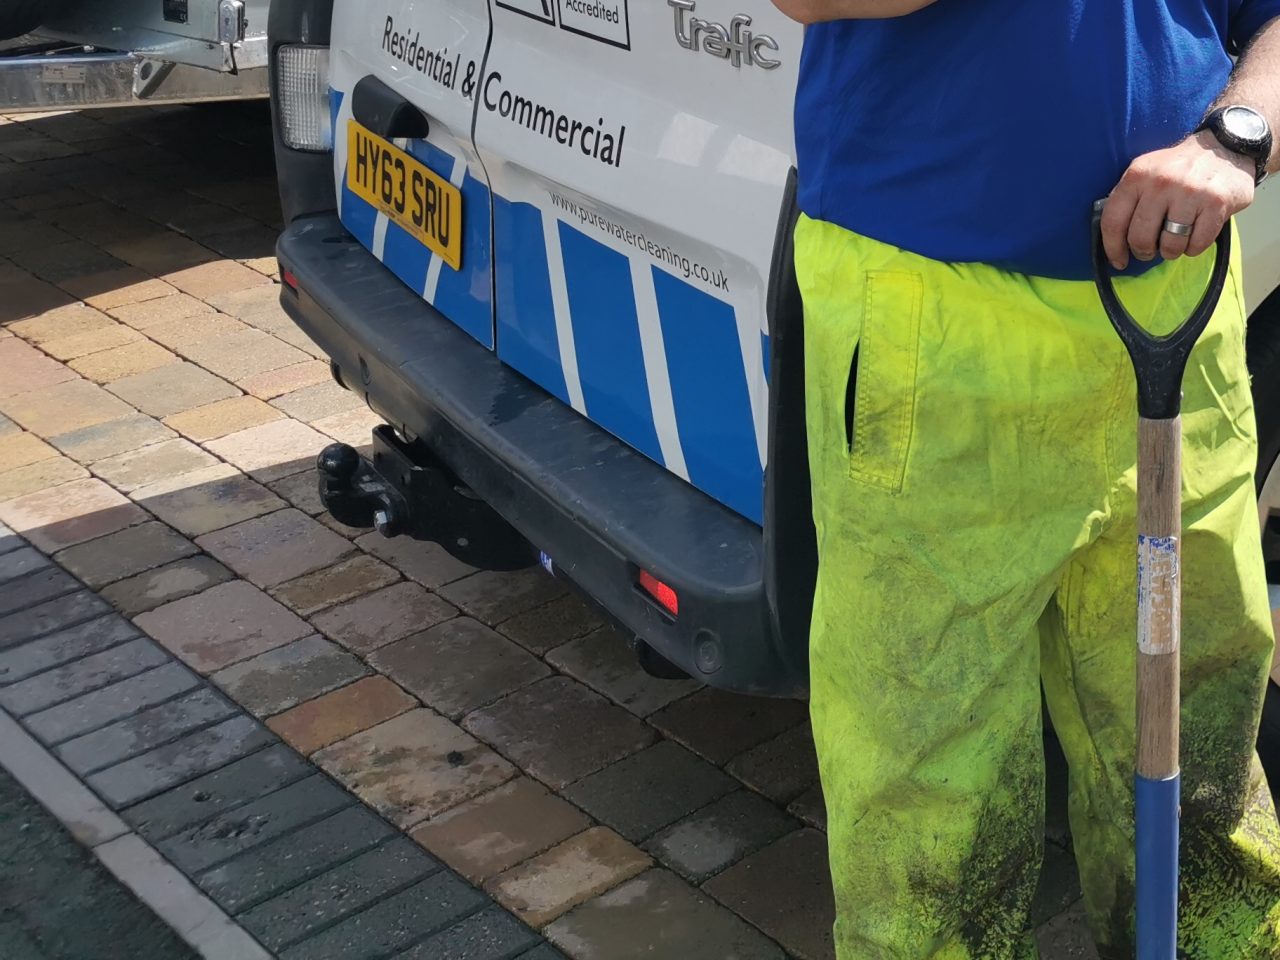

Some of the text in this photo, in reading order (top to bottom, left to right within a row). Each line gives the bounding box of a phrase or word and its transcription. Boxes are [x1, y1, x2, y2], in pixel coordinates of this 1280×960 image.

[382, 16, 626, 168] Residential & Commercial
[357, 132, 406, 214] HY63
[412, 170, 450, 248] SRU
[549, 191, 729, 292] www.purewatercleaning.co.uk
